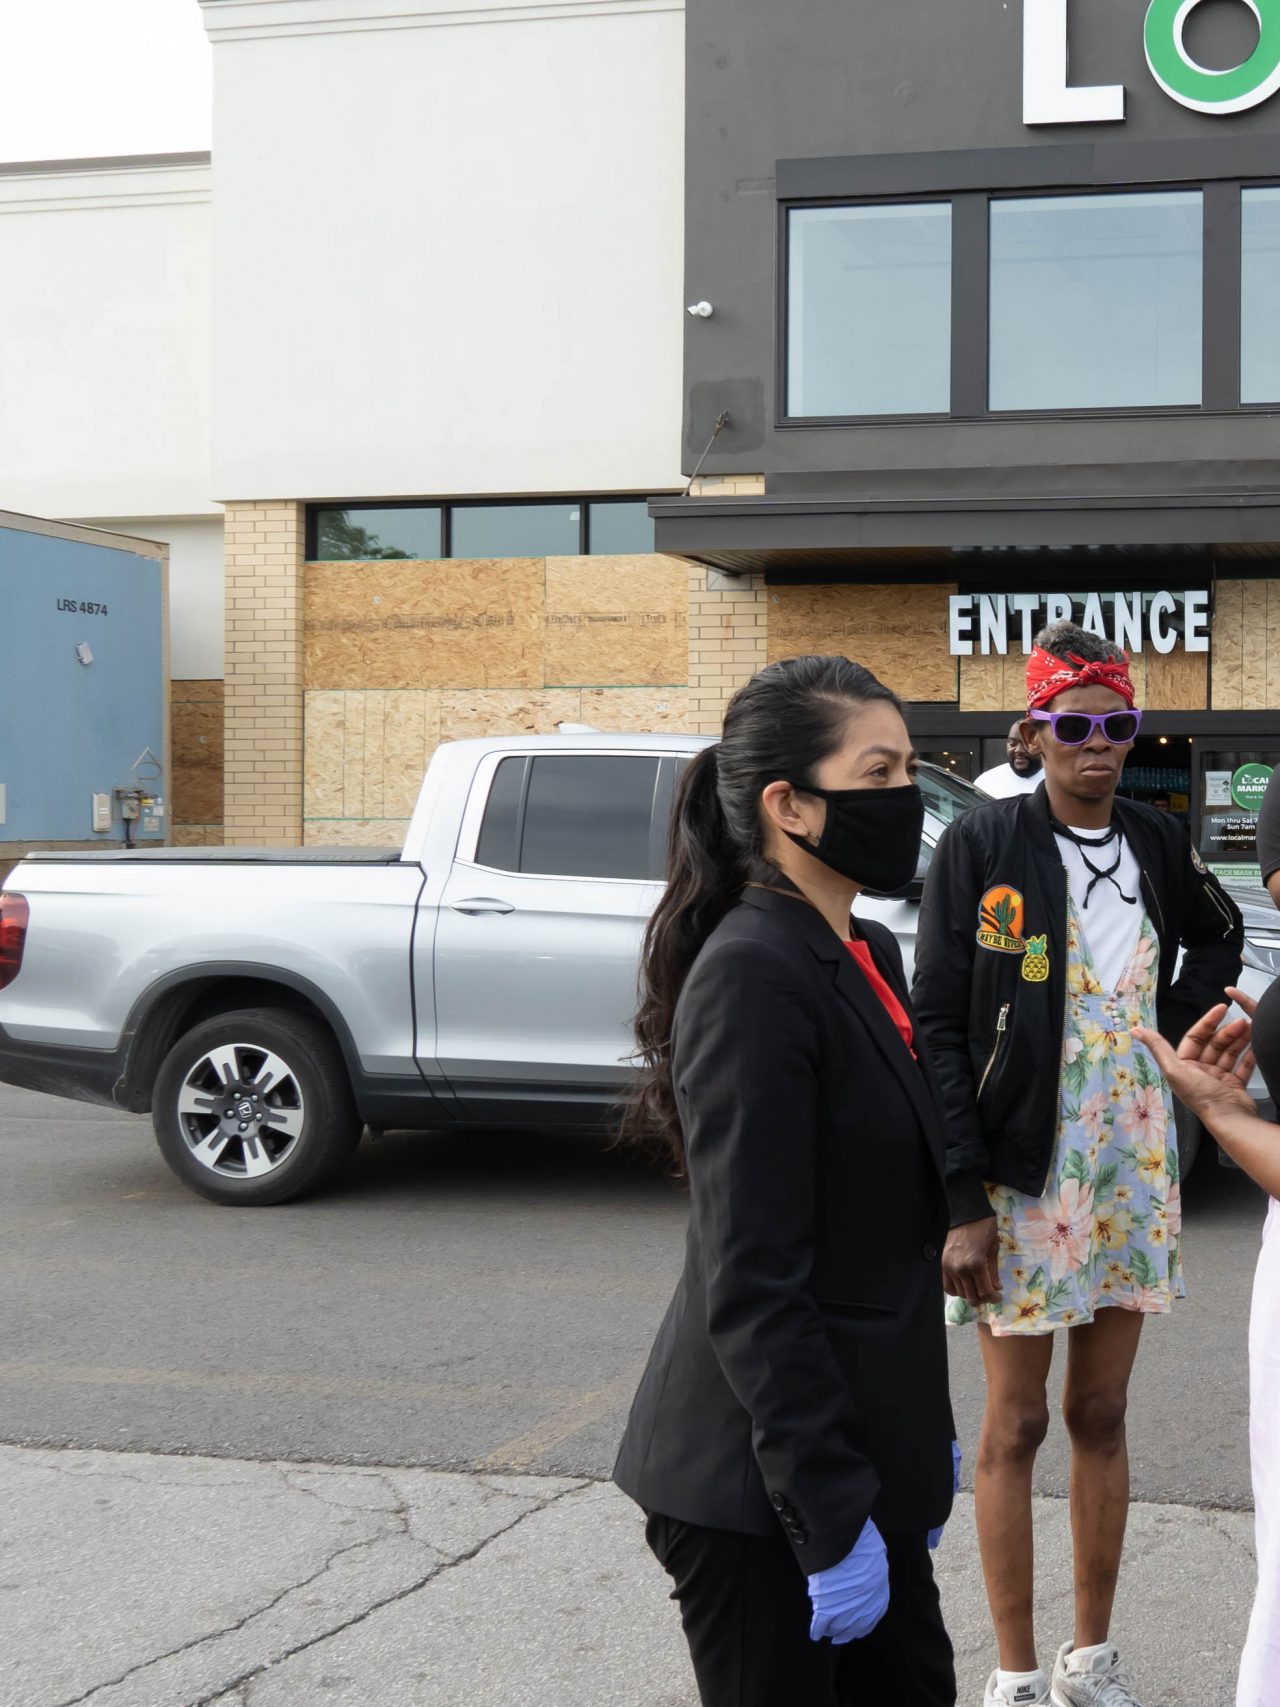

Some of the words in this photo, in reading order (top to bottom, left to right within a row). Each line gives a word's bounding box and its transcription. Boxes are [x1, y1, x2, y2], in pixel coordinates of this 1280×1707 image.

[56, 598, 78, 613] LRS
[80, 601, 108, 617] 4874
[1016, 1685, 1031, 1694] NIKE
